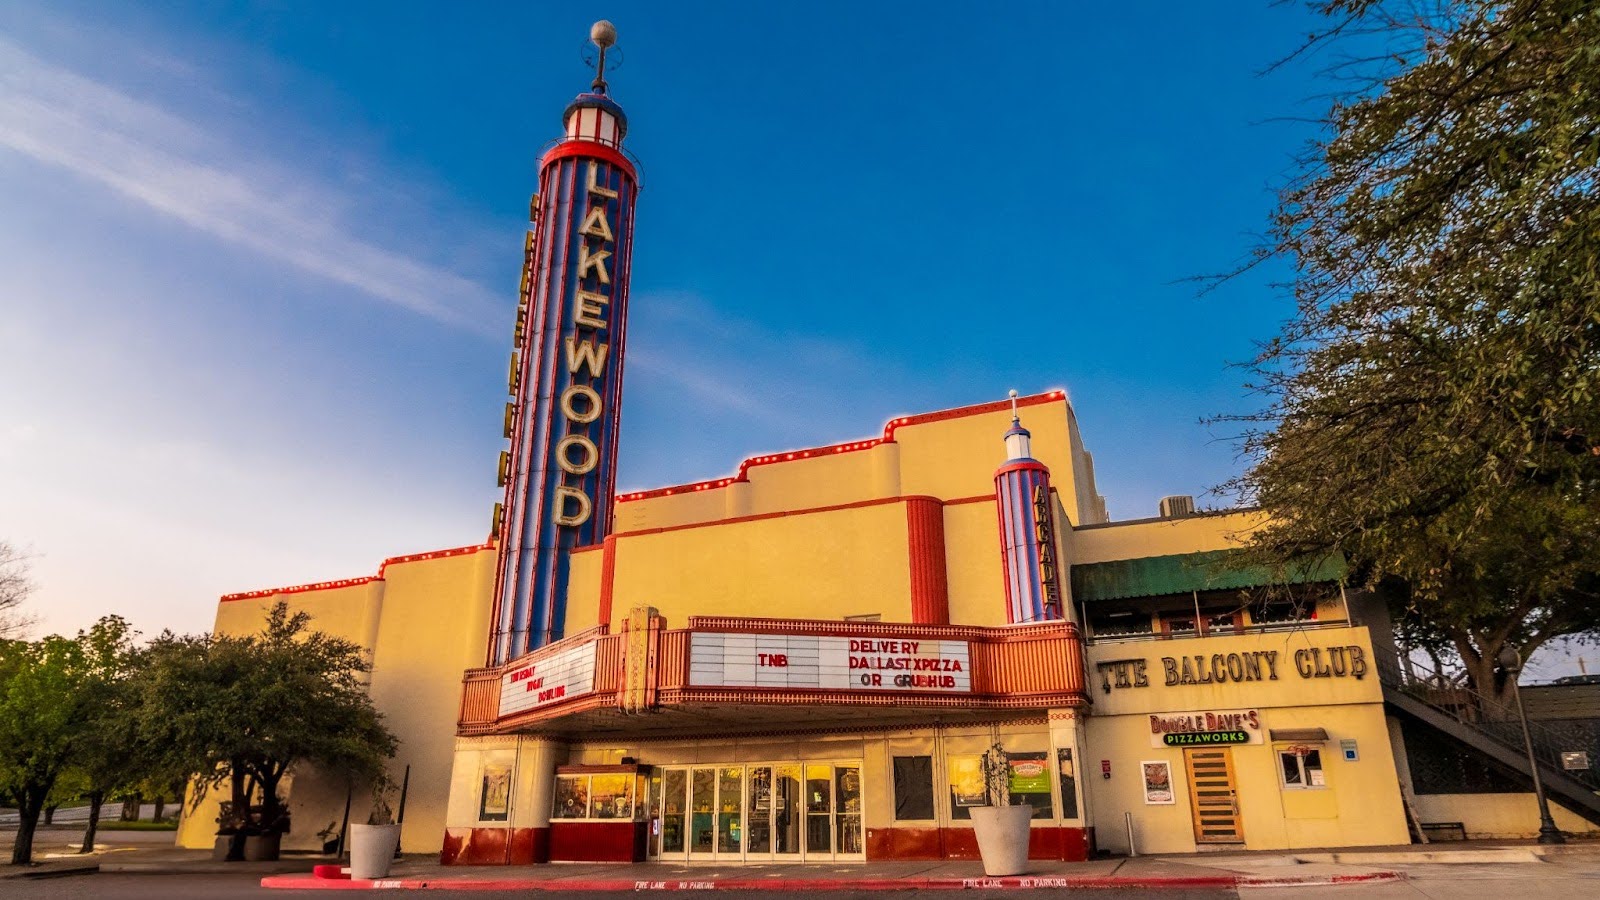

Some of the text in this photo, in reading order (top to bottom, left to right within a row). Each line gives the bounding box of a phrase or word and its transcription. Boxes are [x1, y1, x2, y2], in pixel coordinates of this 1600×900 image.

[552, 159, 618, 528] LAKEWOOD
[850, 640, 919, 654] DELIVERY
[758, 653, 788, 668] TNB
[1097, 645, 1367, 690] THE BALCONY CLUB
[861, 673, 956, 688] OR GRUBHUB
[1167, 732, 1245, 744] PIZZAWORKS
[650, 881, 667, 890] LANE
[678, 881, 688, 889] NO
[689, 881, 715, 889] PARKING
[1034, 878, 1067, 887] PARKING
